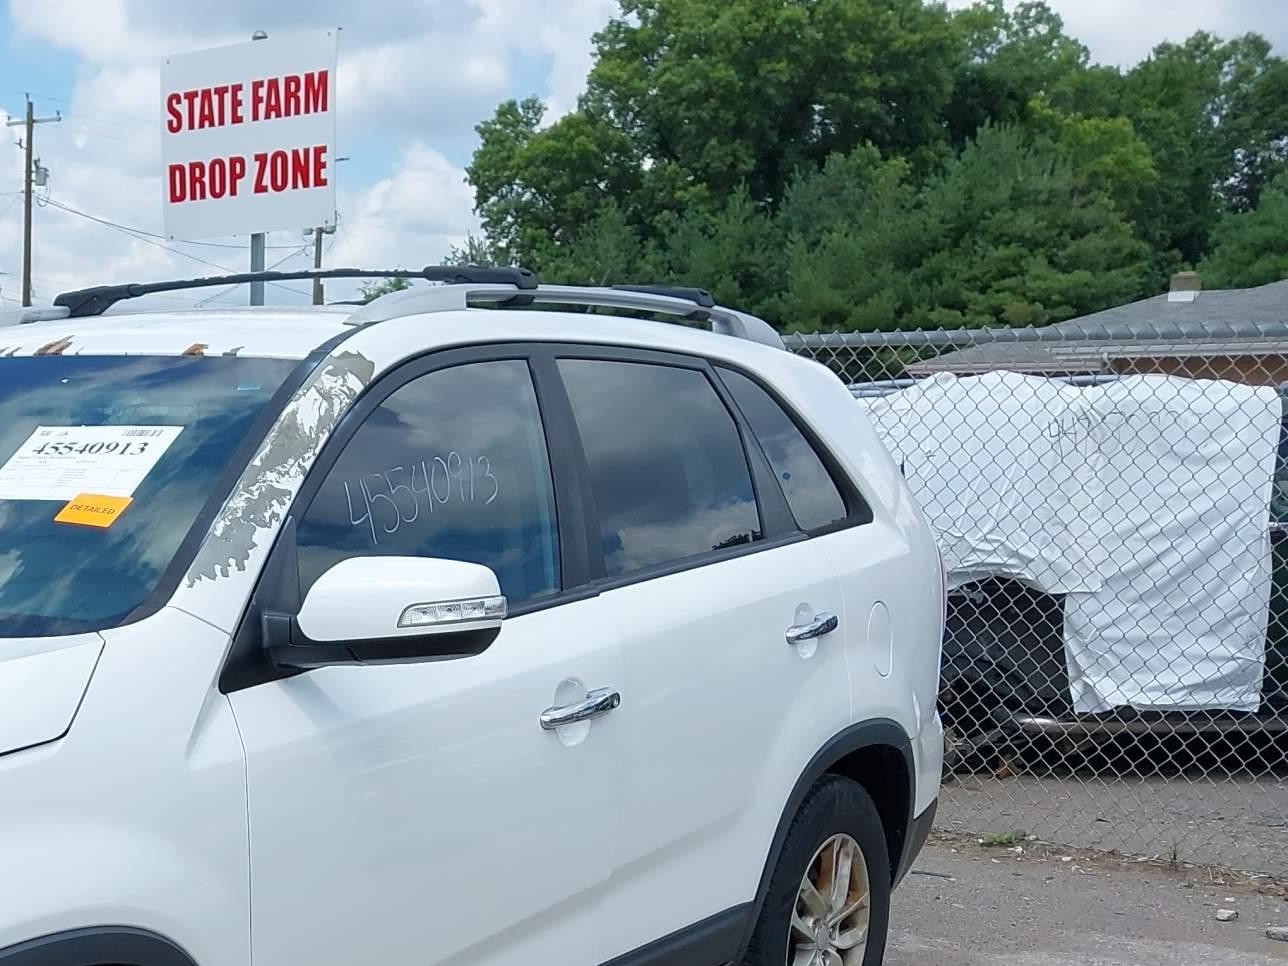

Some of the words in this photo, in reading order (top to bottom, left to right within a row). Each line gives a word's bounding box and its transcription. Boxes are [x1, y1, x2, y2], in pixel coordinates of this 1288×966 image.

[167, 83, 244, 134] STATE
[251, 70, 329, 122] FARM
[168, 156, 246, 203] DROP
[253, 145, 328, 194] ZONE
[31, 441, 150, 456] 45540913
[70, 504, 116, 515] DETAILED
[343, 451, 499, 545] 45540913
